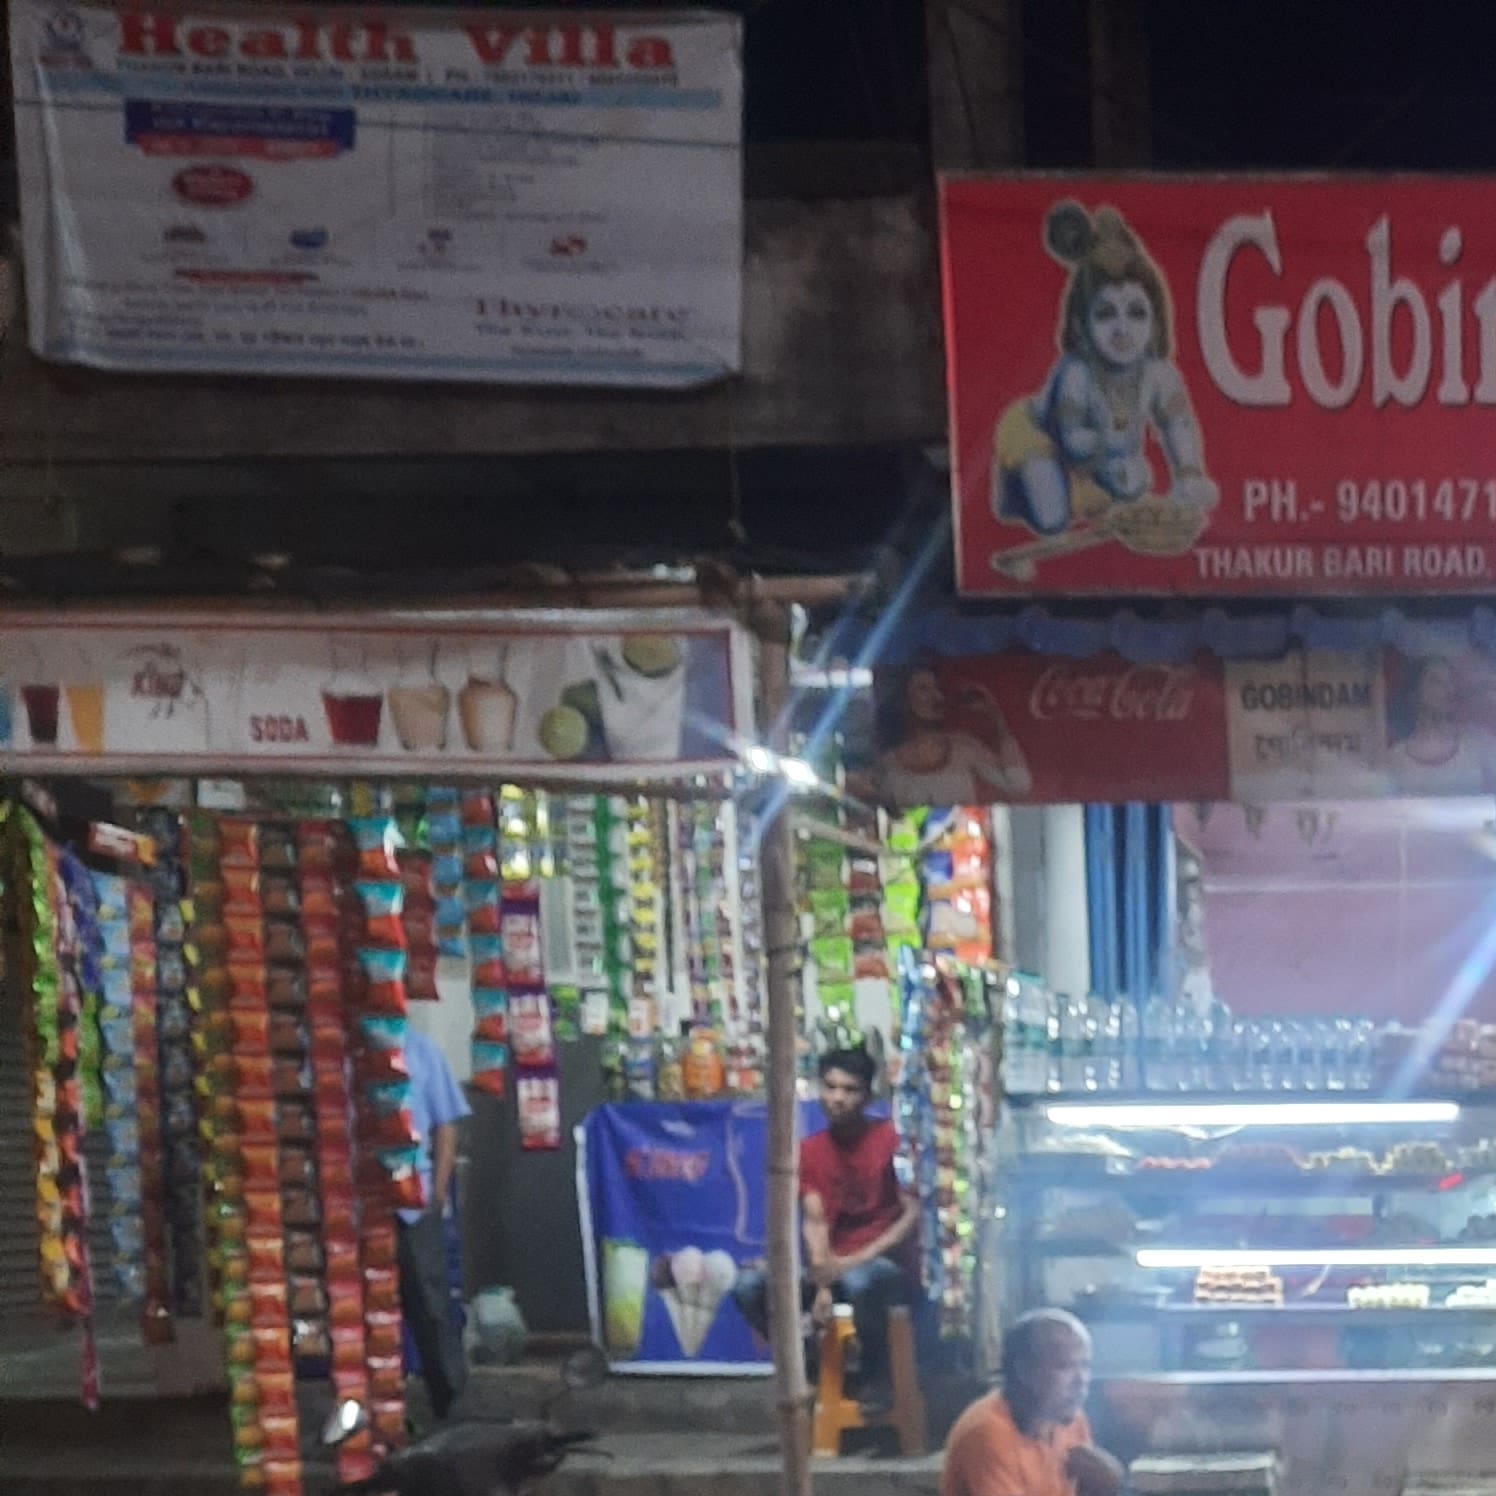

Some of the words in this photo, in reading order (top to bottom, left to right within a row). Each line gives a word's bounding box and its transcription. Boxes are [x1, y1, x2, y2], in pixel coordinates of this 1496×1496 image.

[116, 9, 420, 65] Health
[463, 23, 677, 69] Villa
[1196, 544, 1314, 579] THAKUR
[1322, 544, 1392, 578] BARI
[1028, 662, 1197, 722] Coca-Cola
[250, 714, 309, 743] SODA
